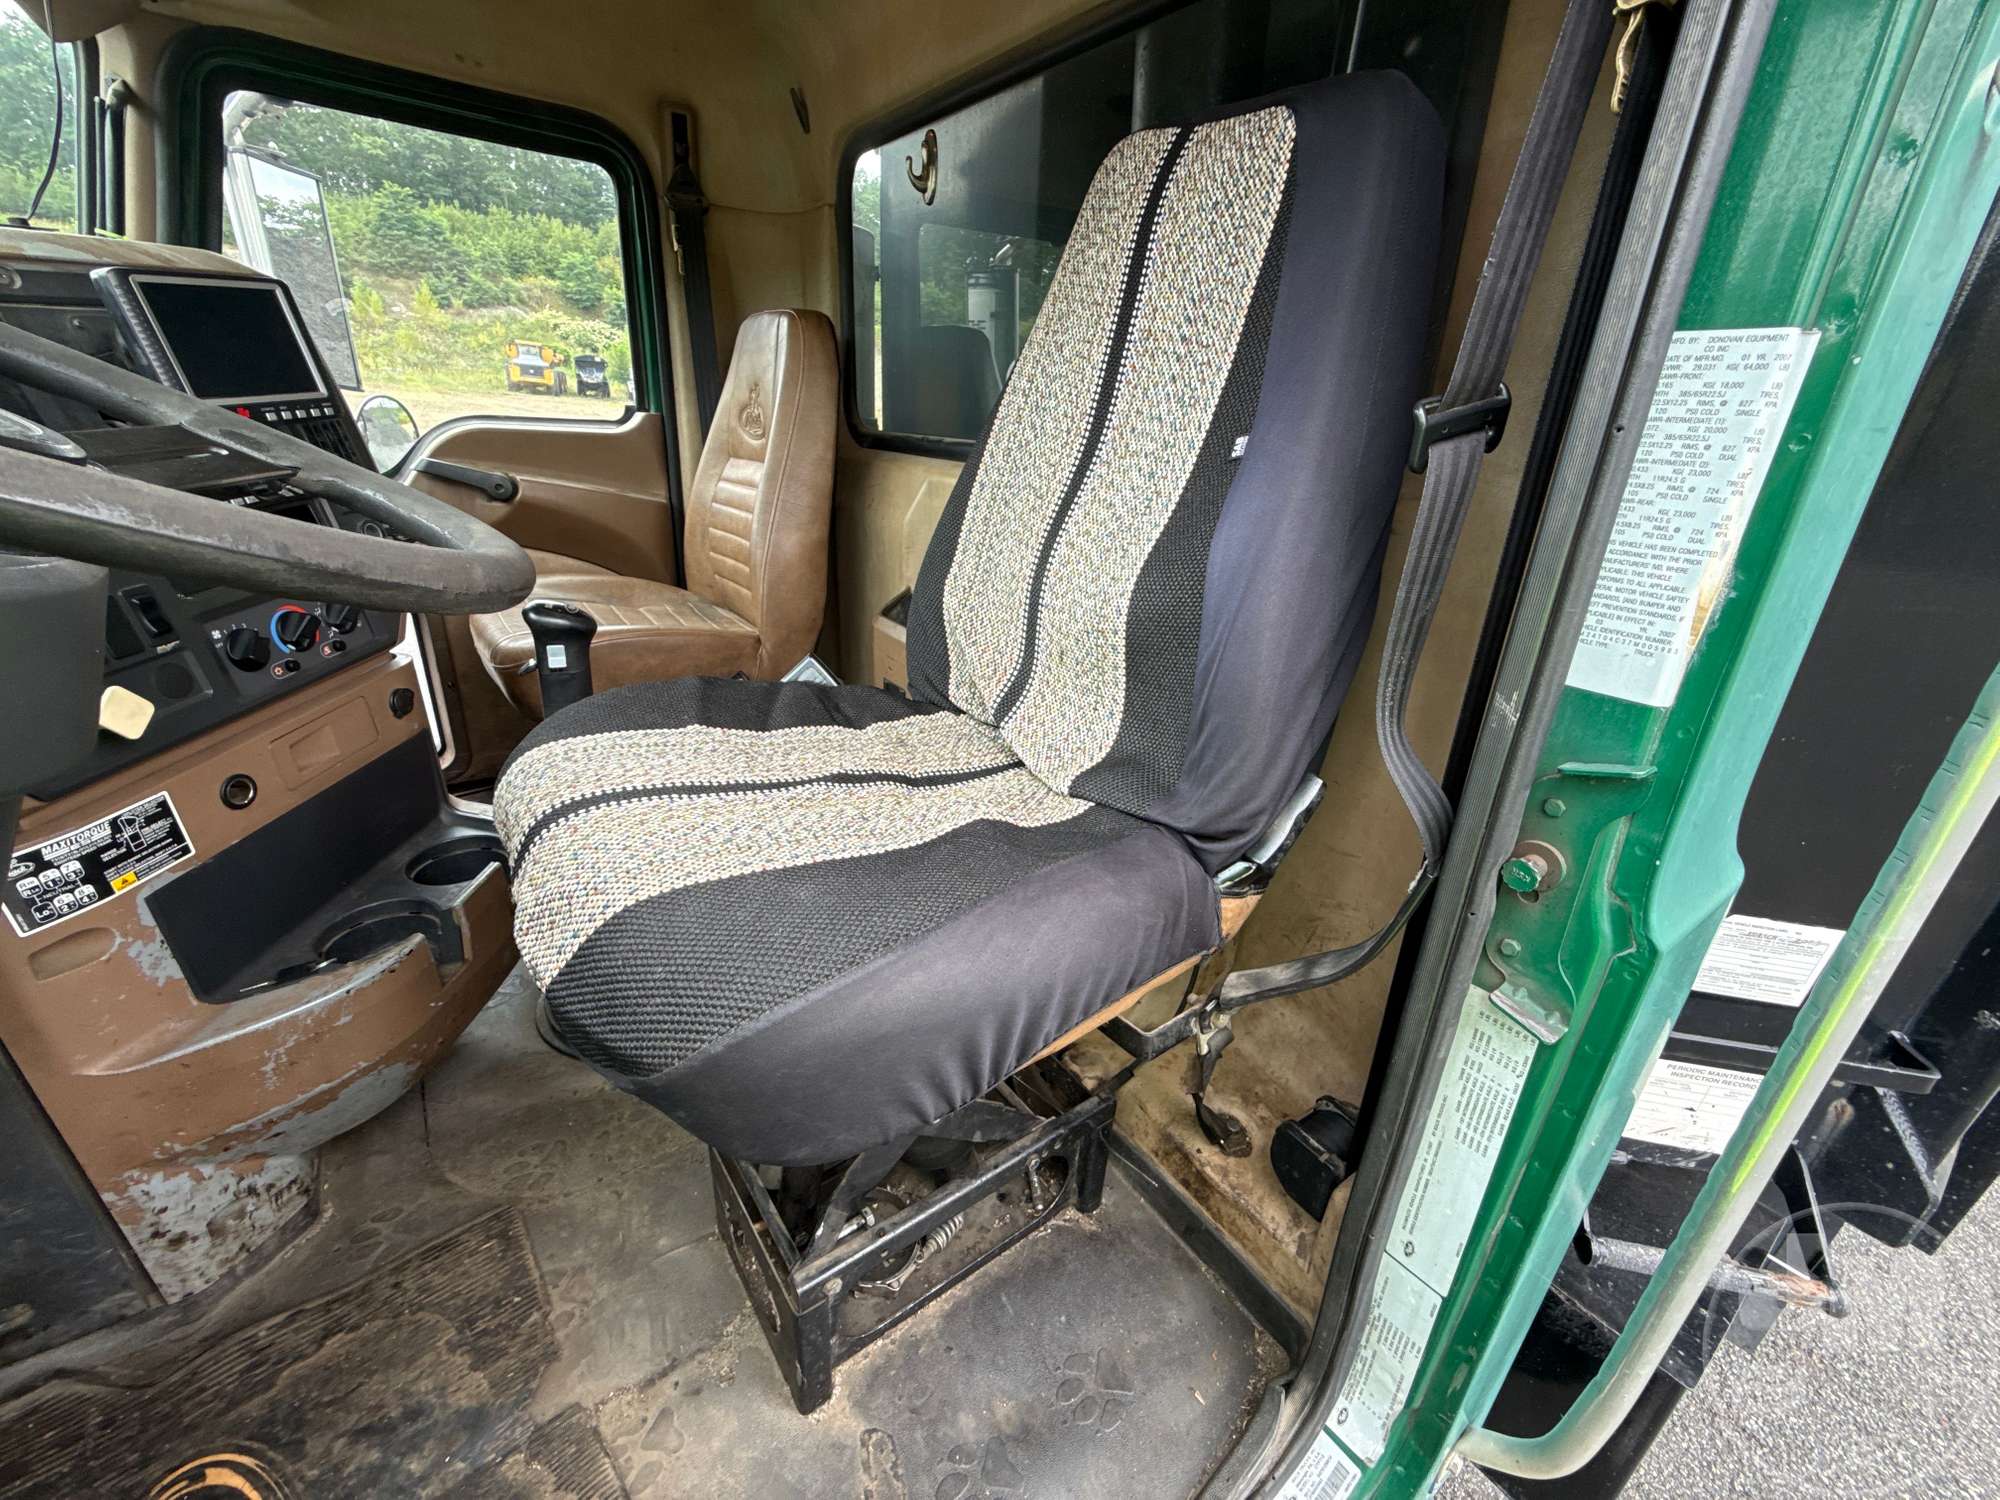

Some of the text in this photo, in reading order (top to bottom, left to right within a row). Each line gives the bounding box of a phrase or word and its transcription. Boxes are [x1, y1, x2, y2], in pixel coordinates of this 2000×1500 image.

[1708, 336, 1744, 344] DONOVAN
[1745, 334, 1790, 343] EQUIPMENT
[1683, 354, 1693, 362] OF
[1743, 363, 1769, 371] 64,000
[1720, 382, 1744, 390] 18,000
[1701, 408, 1720, 416] COLD
[1718, 453, 1737, 461] DUAL
[1688, 469, 1711, 477] 23,000
[1671, 493, 1689, 501] COLD
[1702, 496, 1728, 504] SINGLE
[1673, 511, 1697, 519] 23,000
[1656, 532, 1675, 540] COLD
[1687, 536, 1706, 544] DUAL
[1618, 540, 1643, 550] VEHICLE
[1644, 543, 1659, 551] HAS
[1659, 545, 1677, 553] BEEN
[1678, 547, 1719, 558] COMPLETED
[1607, 548, 1703, 566] ACCORDANCE WITH THE PRIOR
[1665, 565, 1690, 575] WHERE
[1646, 572, 1673, 581] VEHICLE
[1626, 578, 1635, 586] TO
[1635, 580, 1648, 588] ALL
[1615, 585, 1638, 595] MOTOR
[1638, 589, 1664, 600] VEHICLE
[1601, 602, 1637, 614] PREVENTION
[1639, 600, 1665, 609] BUMPER
[1666, 604, 1682, 612] AND
[1615, 613, 1624, 621] IN
[1624, 615, 1647, 626] EFFECT
[1599, 626, 1644, 640] IDENTIFICATION
[1633, 648, 1655, 657] TRUCK
[41, 821, 110, 855] MAXITORQUE
[60, 904, 70, 912] 2
[1666, 1063, 1708, 1075] PERIODIC
[1670, 1071, 1720, 1084] INSPECTION
[1721, 1080, 1758, 1090] RECORD
